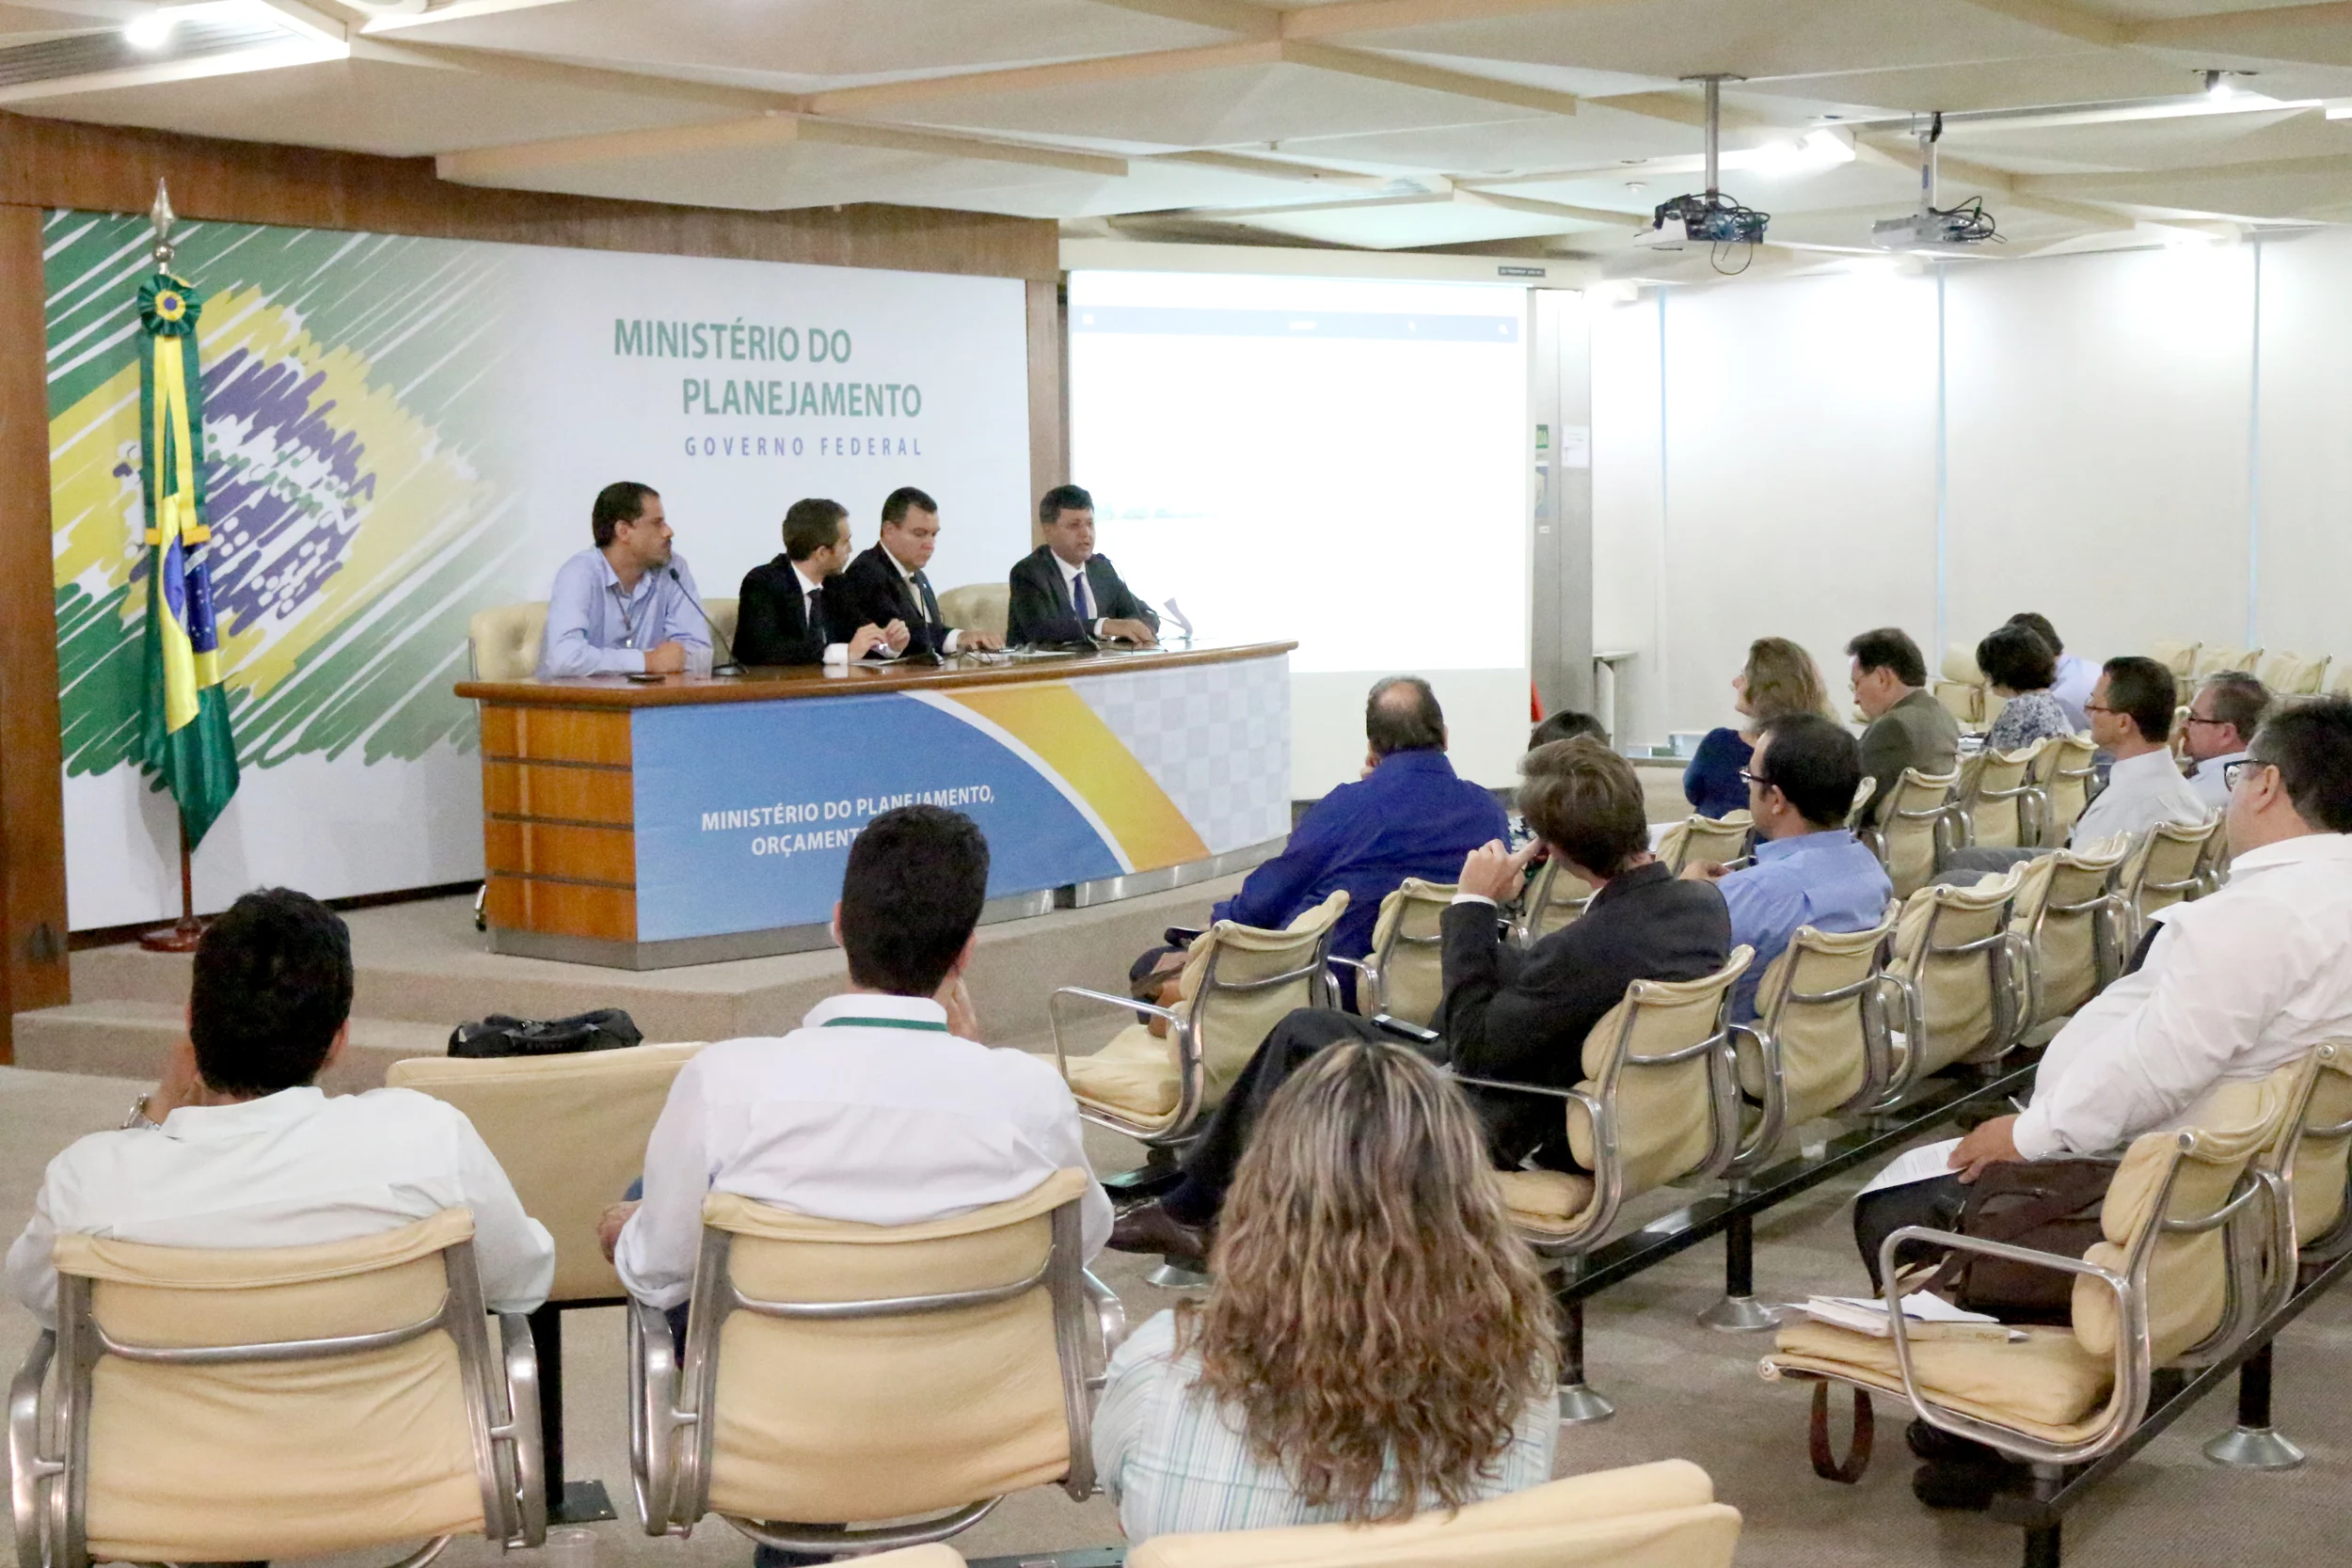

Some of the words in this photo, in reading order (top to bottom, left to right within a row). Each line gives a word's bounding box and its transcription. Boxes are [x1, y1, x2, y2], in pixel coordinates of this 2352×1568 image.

[613, 316, 800, 362] MINISTÉRIO
[808, 328, 851, 363] DO
[682, 378, 922, 418] PLANEJAMENTO
[685, 436, 803, 456] GOVERNO
[820, 436, 922, 456] FEDERAL
[701, 802, 818, 832] MINISTÉRIO
[824, 800, 851, 820] DO
[751, 827, 867, 858] ORÇAMENT
